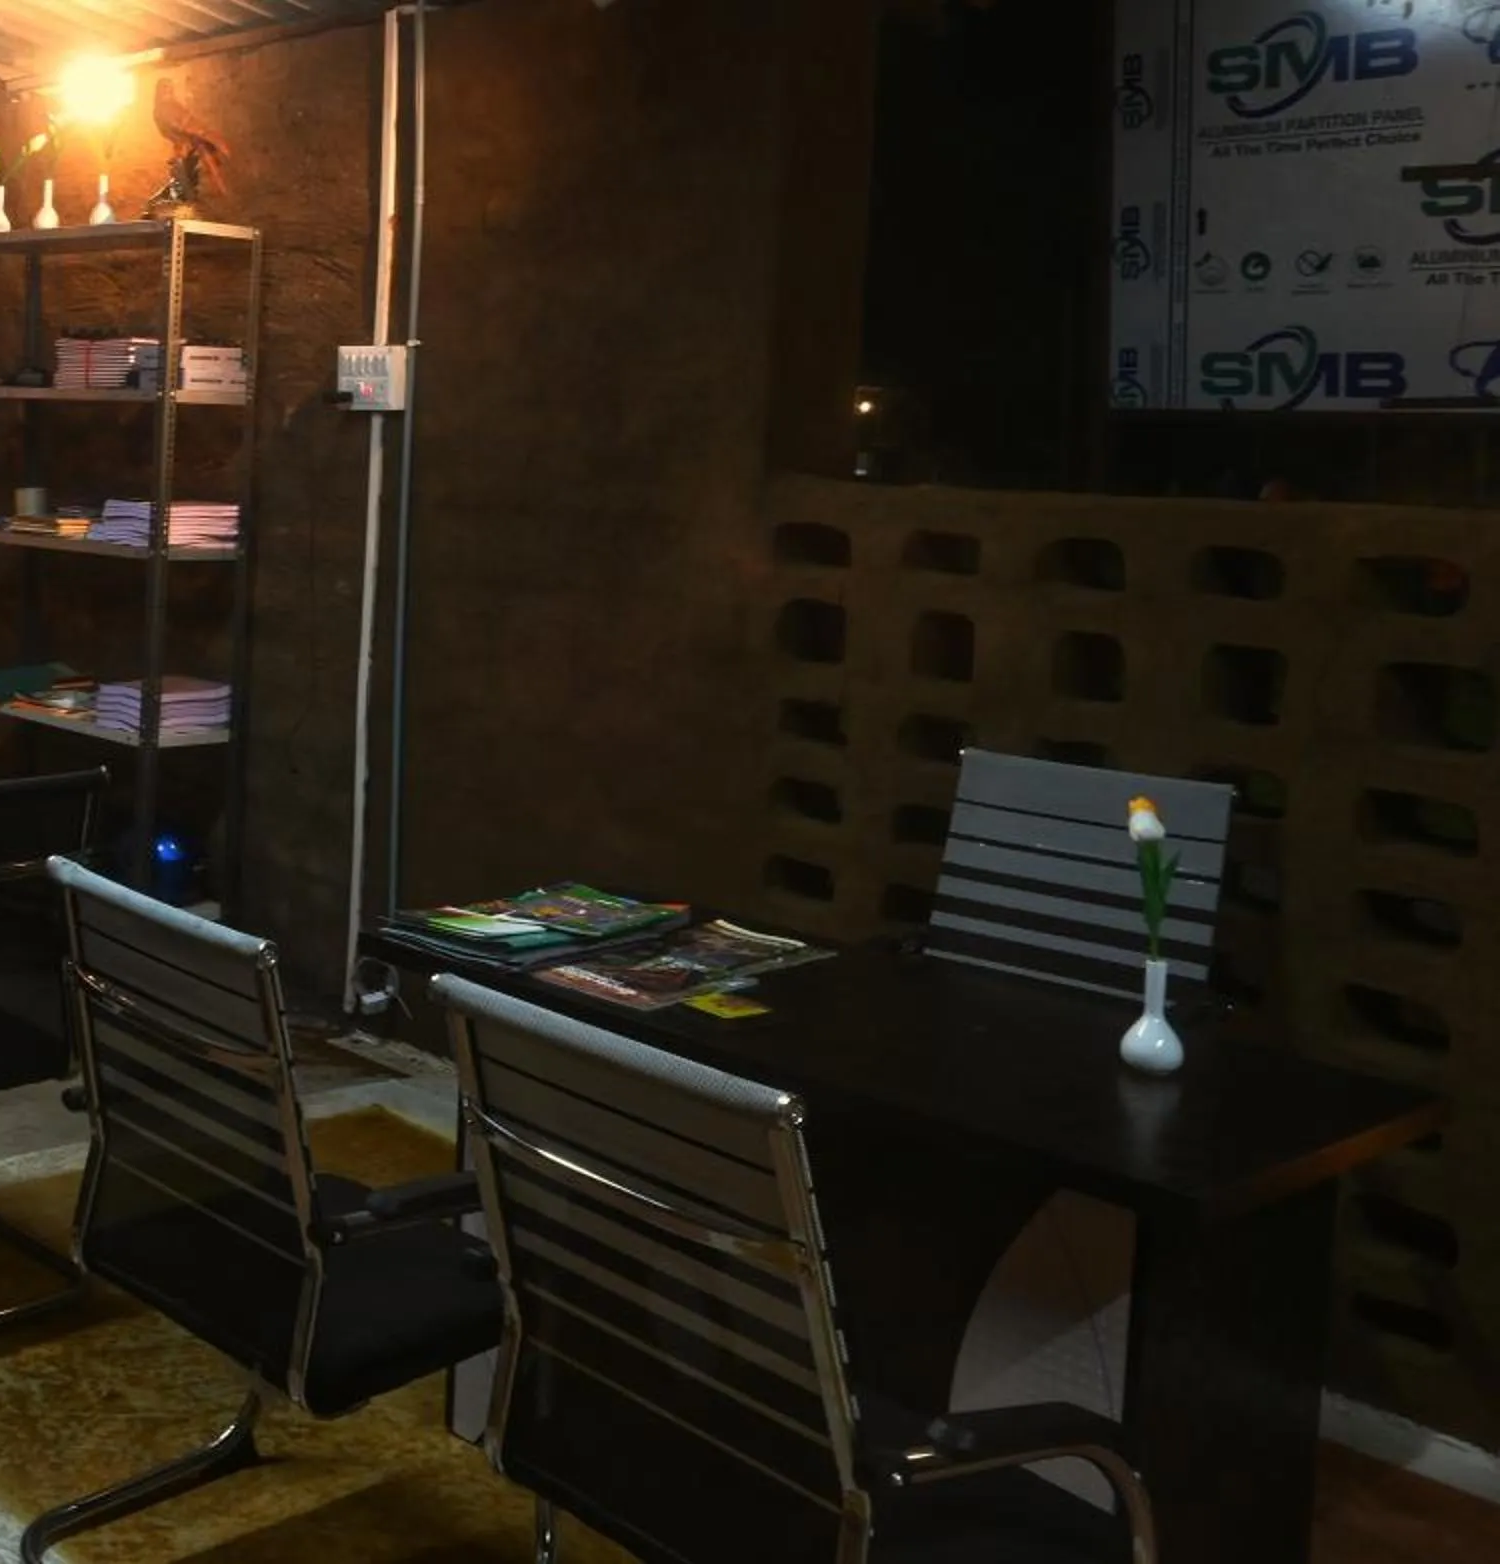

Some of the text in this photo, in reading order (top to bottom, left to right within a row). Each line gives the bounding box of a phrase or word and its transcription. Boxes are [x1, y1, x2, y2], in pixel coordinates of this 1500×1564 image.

[1206, 26, 1418, 95] SMB
[1286, 111, 1368, 131] PARTITION
[1306, 135, 1361, 152] Perfect
[1365, 131, 1421, 147] Choice
[1200, 346, 1408, 400] SMB
